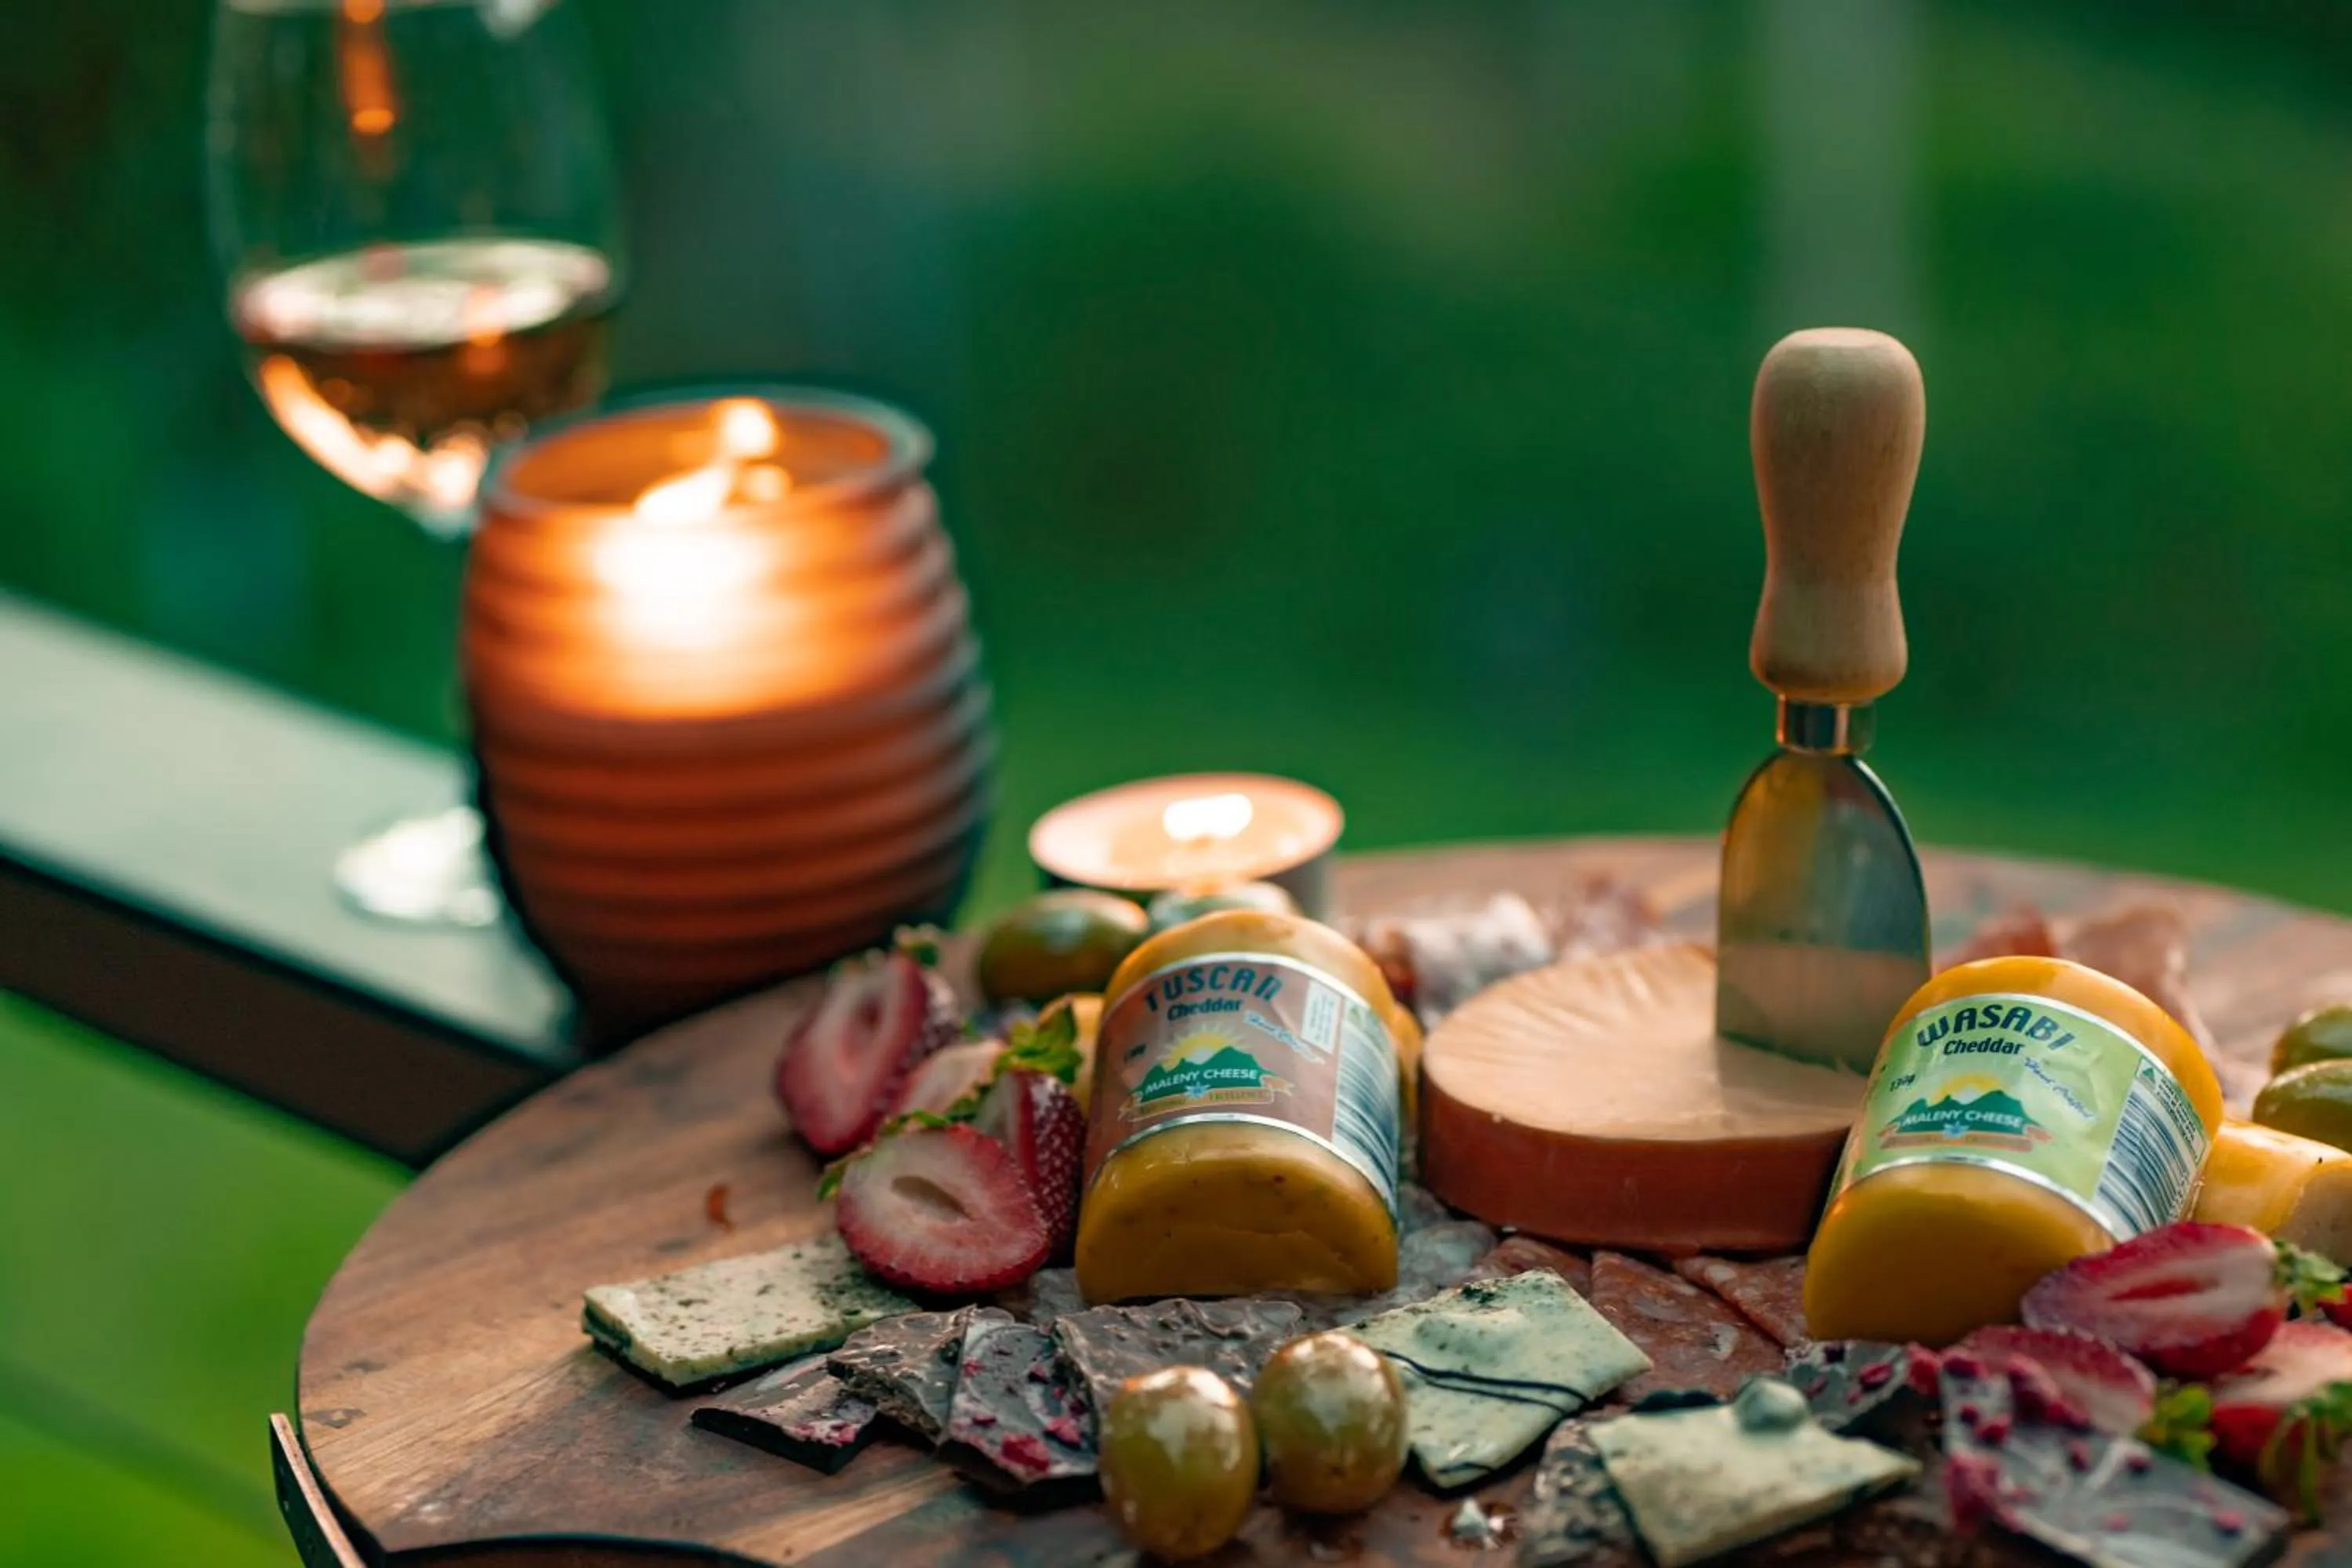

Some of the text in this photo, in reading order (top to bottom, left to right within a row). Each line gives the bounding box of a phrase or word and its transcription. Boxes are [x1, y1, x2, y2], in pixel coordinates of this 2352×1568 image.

[1167, 997, 1244, 1021] Cheddar
[1917, 1004, 2076, 1051] WASABI
[1944, 1037, 2025, 1055] Cheddar
[1145, 1068, 1258, 1094] MALENY CHEESE
[1903, 1109, 2024, 1128] MALENY CHEESE
